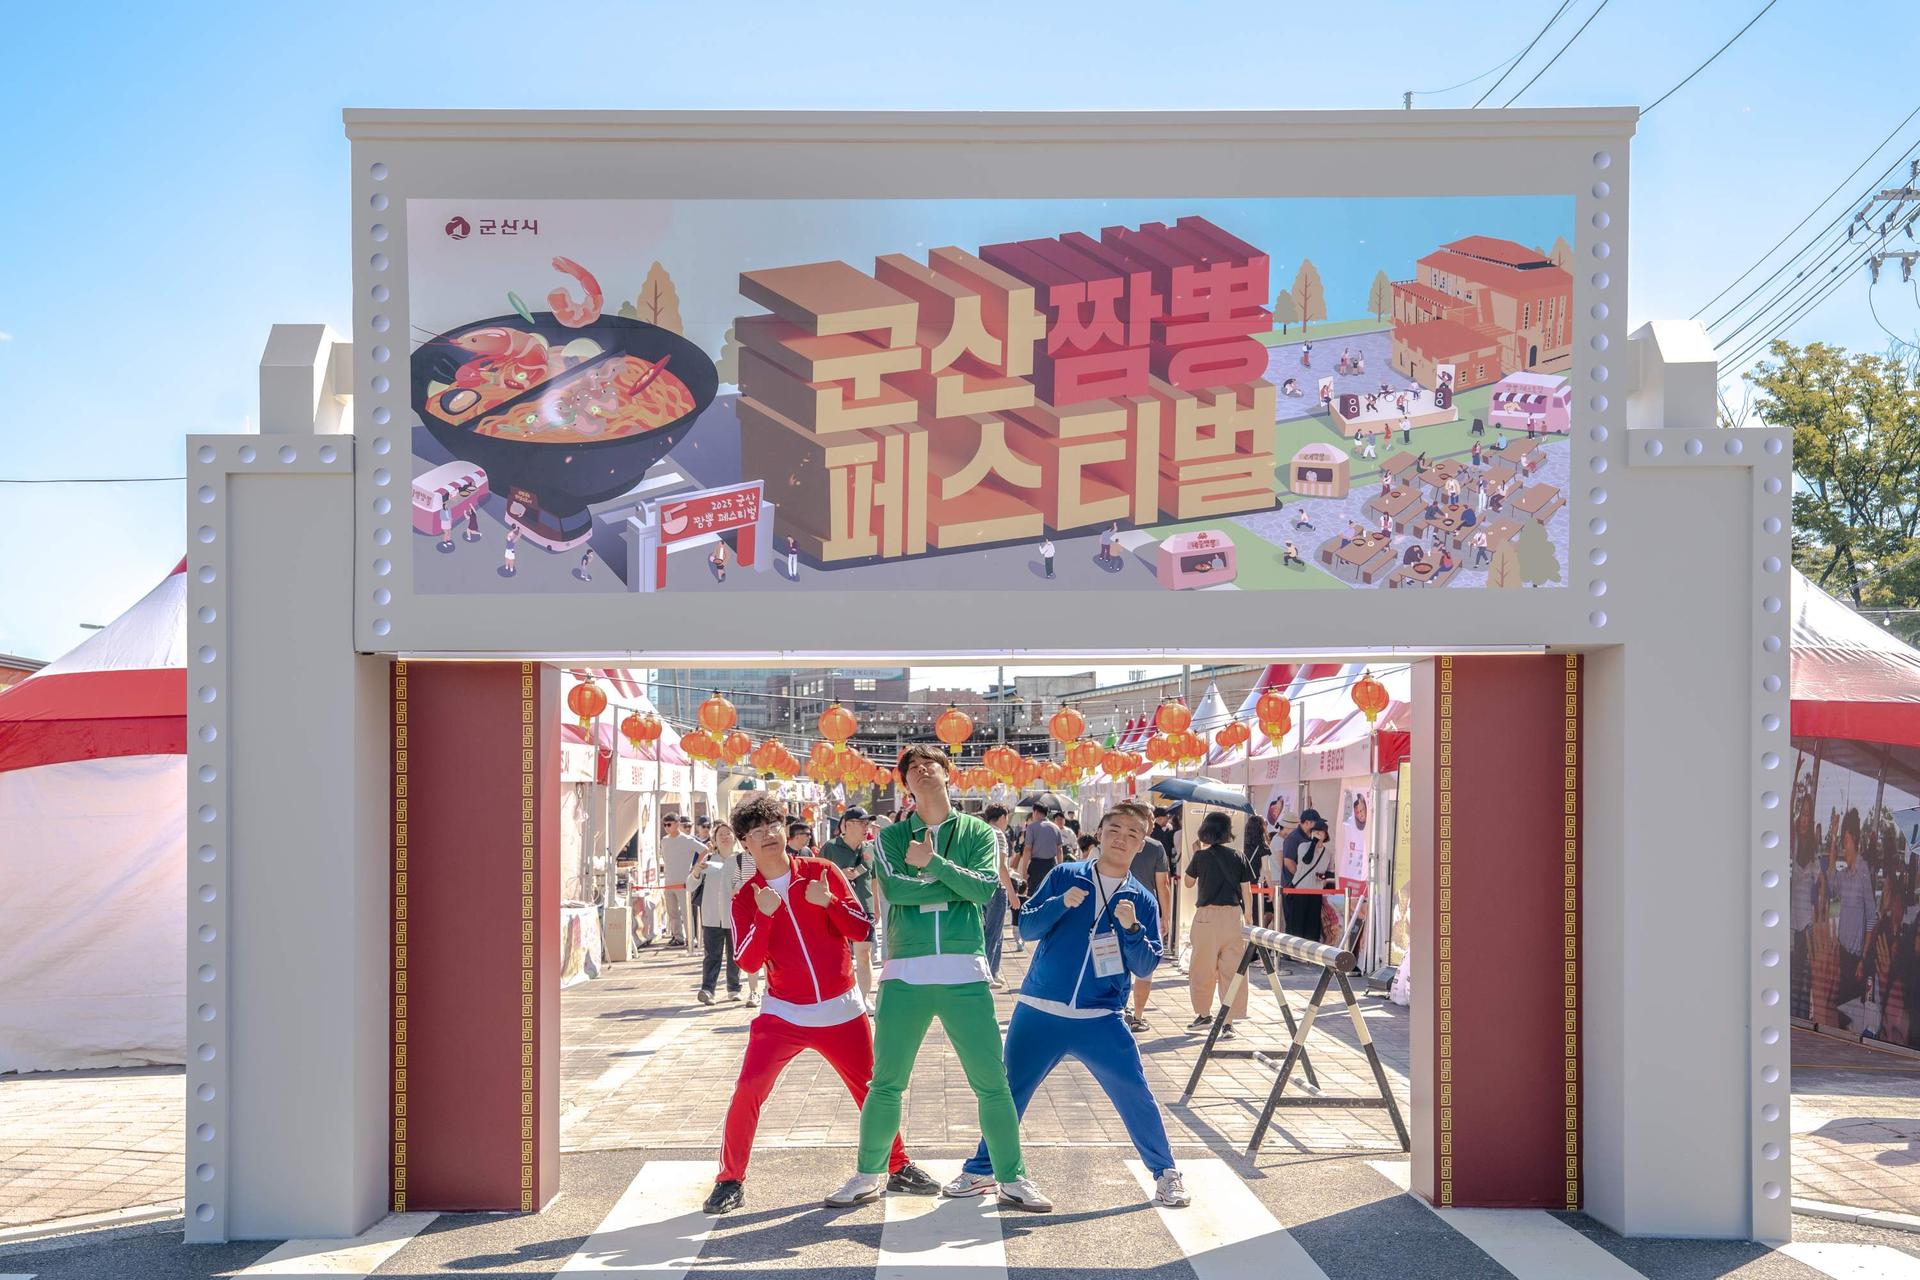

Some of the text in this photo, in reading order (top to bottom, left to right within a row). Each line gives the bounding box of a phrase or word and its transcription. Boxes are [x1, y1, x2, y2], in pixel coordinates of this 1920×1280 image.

[479, 219, 538, 235] 군산시
[813, 253, 1273, 434] 군산 짬뽕
[817, 379, 1276, 562] 페스티벌
[711, 493, 756, 510] 2025 군산
[693, 506, 757, 529] 짬뽕 페스티벌
